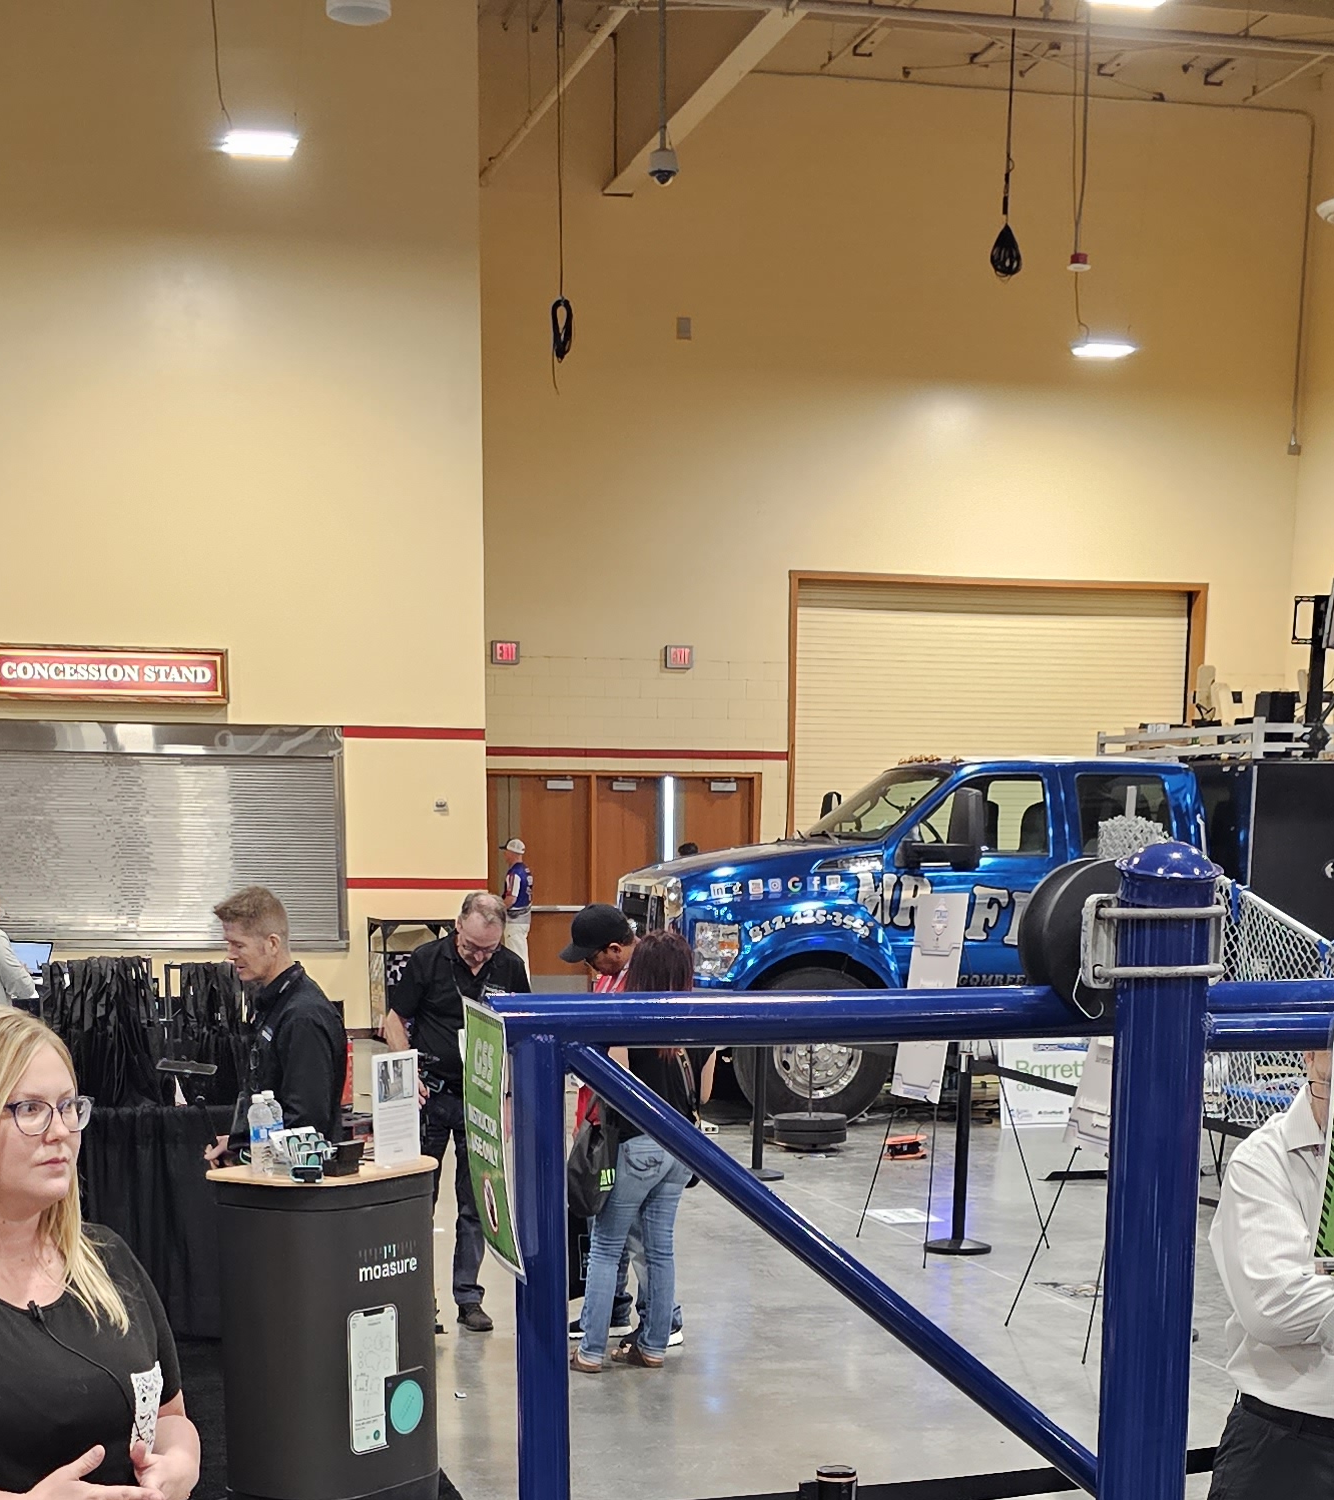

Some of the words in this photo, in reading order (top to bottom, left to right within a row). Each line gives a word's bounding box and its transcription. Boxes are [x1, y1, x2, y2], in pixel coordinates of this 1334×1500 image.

[496, 642, 517, 661] EXIT
[670, 647, 691, 665] EXIT
[0, 661, 140, 682] CONCESSION
[143, 666, 213, 683] STAND
[474, 1037, 495, 1083] GSS
[358, 1256, 418, 1283] moasure
